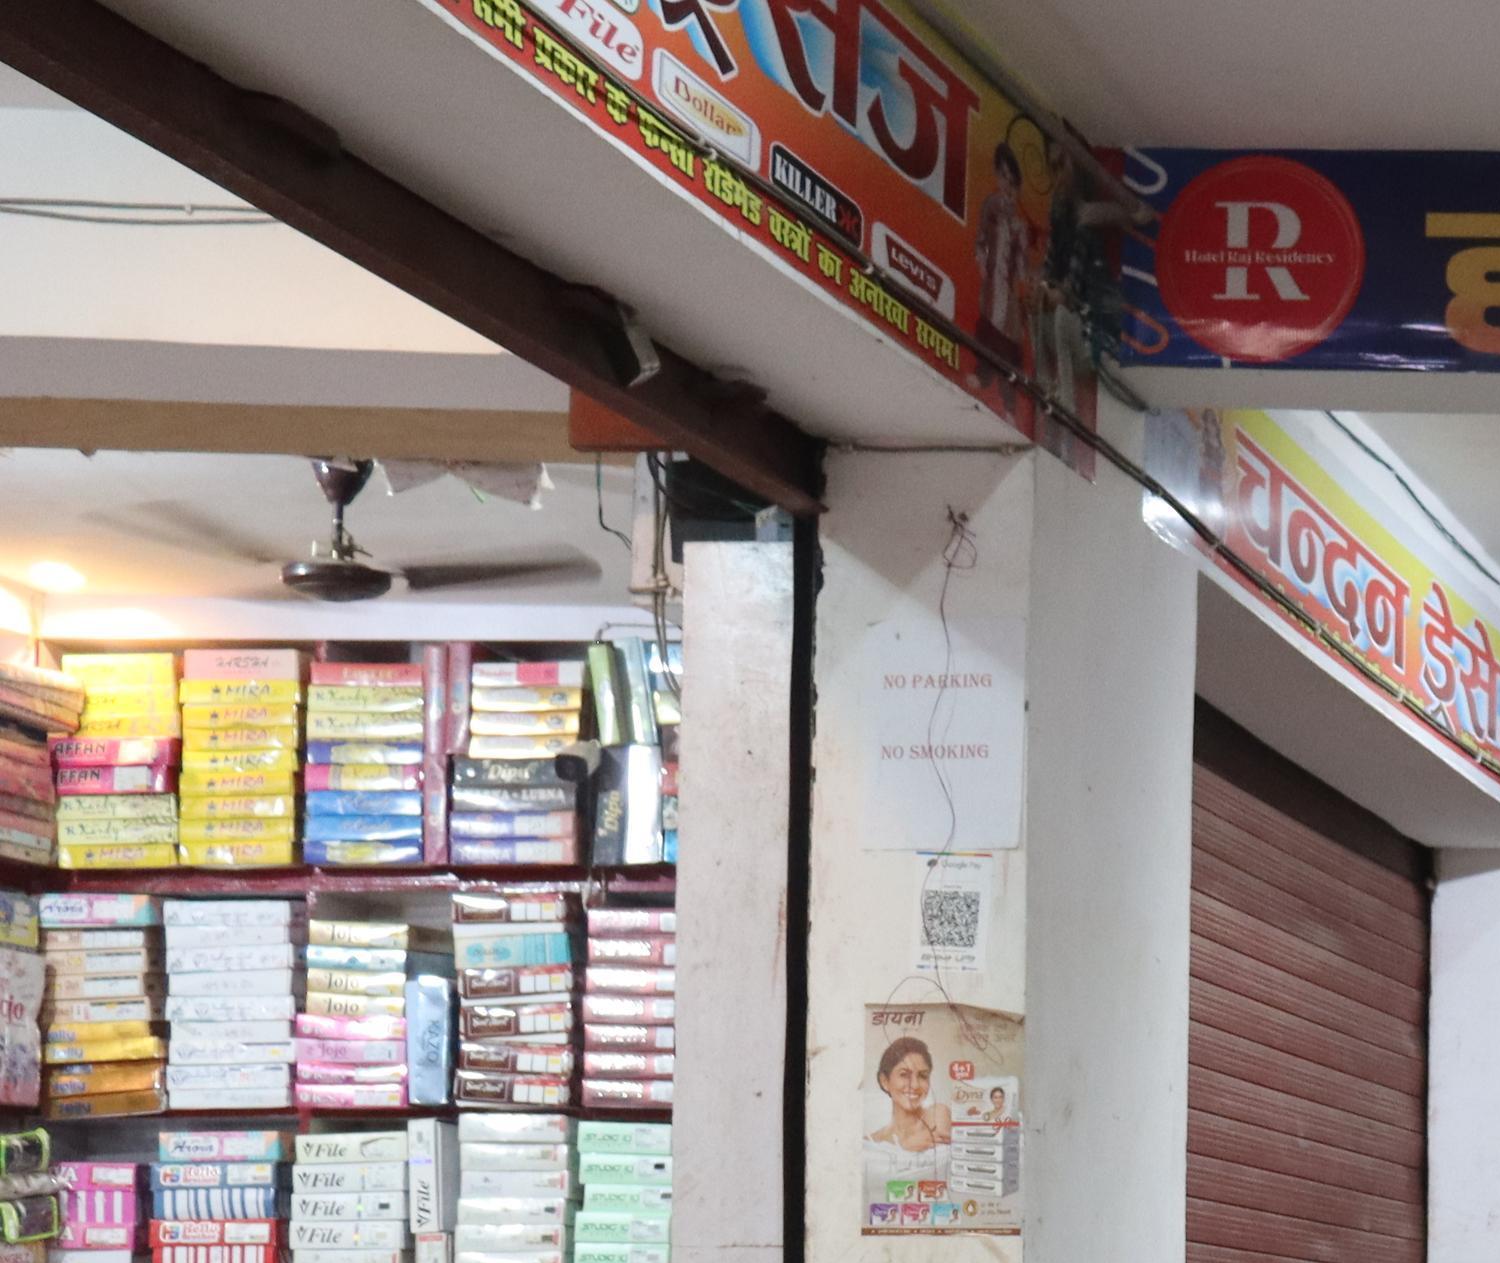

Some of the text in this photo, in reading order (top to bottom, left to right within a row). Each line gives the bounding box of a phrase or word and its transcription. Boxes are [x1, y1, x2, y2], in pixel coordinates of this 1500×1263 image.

[774, 152, 838, 223] KILLER
[1184, 249, 1225, 264] Hotel
[1213, 200, 1311, 301] R
[883, 673, 993, 690] NO PARKING
[880, 743, 990, 760] NO SMOKING
